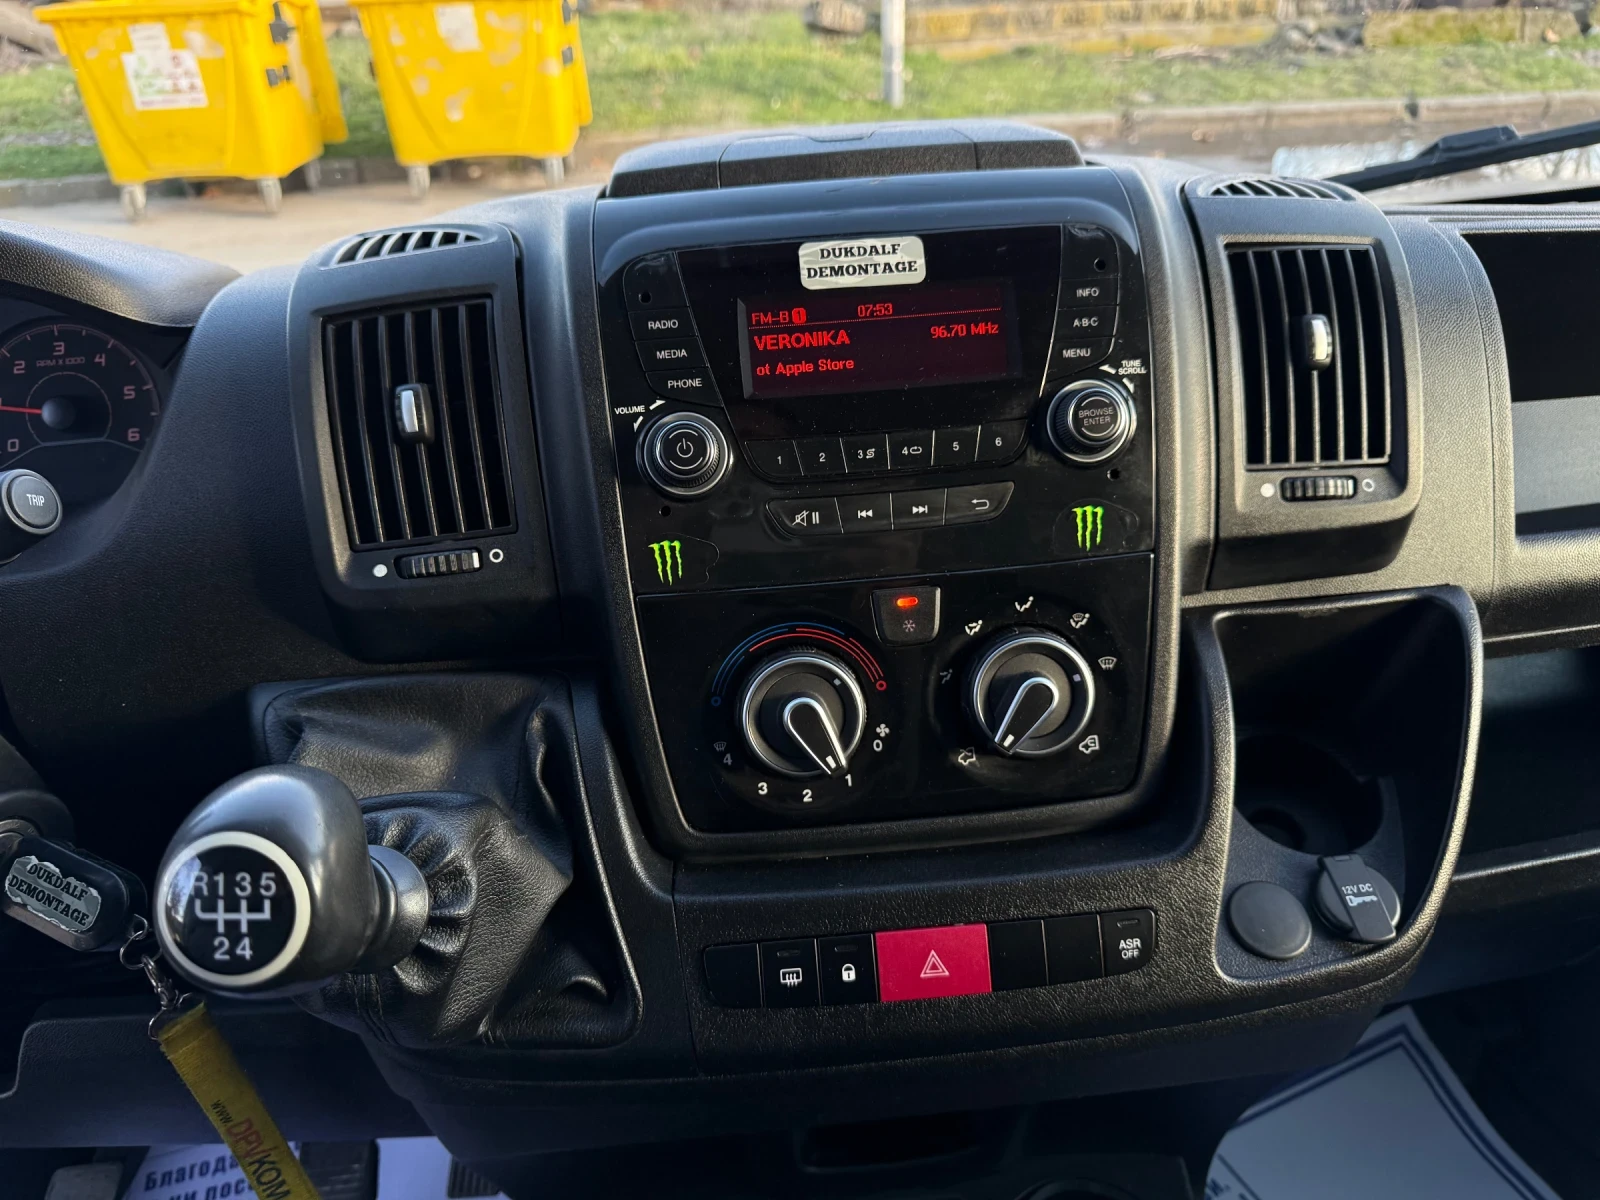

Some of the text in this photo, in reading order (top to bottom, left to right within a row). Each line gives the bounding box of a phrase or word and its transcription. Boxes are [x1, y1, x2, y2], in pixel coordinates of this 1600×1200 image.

[819, 243, 901, 260] DUKDALF
[806, 260, 918, 280] DEMONTAGE
[1076, 288, 1100, 298] INFO
[751, 312, 790, 325] FM-B
[857, 303, 893, 317] 07:53
[647, 319, 679, 330] RADIO
[930, 321, 999, 339] 96.70 MHz
[754, 329, 850, 351] VERONIKA
[53, 342, 65, 355] 3
[656, 349, 688, 360] MEDIA
[1062, 348, 1092, 358] MENU
[36, 359, 56, 367] RPM
[93, 353, 106, 366] 4
[1121, 359, 1143, 368] TUNE
[13, 360, 26, 374] 2
[775, 360, 814, 377] Apple
[818, 358, 855, 371] Store
[1117, 366, 1148, 376] SCROLL
[667, 378, 703, 389] PHONE
[123, 385, 136, 400] 5
[614, 405, 646, 415] VOLUME
[1078, 406, 1115, 418] BROWSE
[1083, 415, 1111, 426] ENTER
[127, 428, 140, 442] 6
[995, 436, 1002, 447] 6
[7, 438, 20, 452] 0
[901, 446, 909, 456] 4
[952, 441, 960, 451] 5
[777, 456, 782, 465] 1
[819, 452, 826, 463] 2
[857, 450, 863, 459] 3
[26, 493, 45, 507] TRIP
[872, 739, 883, 752] 0
[723, 753, 733, 766] 4
[844, 773, 853, 787] 1
[757, 782, 768, 795] 3
[802, 789, 813, 803] 2
[27, 863, 89, 902] DUKDALF
[213, 872, 225, 897] 1
[234, 871, 253, 897] 3
[259, 871, 277, 897] 5
[1341, 882, 1373, 895] 12V DC
[8, 874, 90, 927] DEMONTAGE
[213, 935, 254, 960] 2 4
[1119, 938, 1142, 950] ASR
[1121, 949, 1140, 959] OFF
[144, 1155, 240, 1192] Благода
